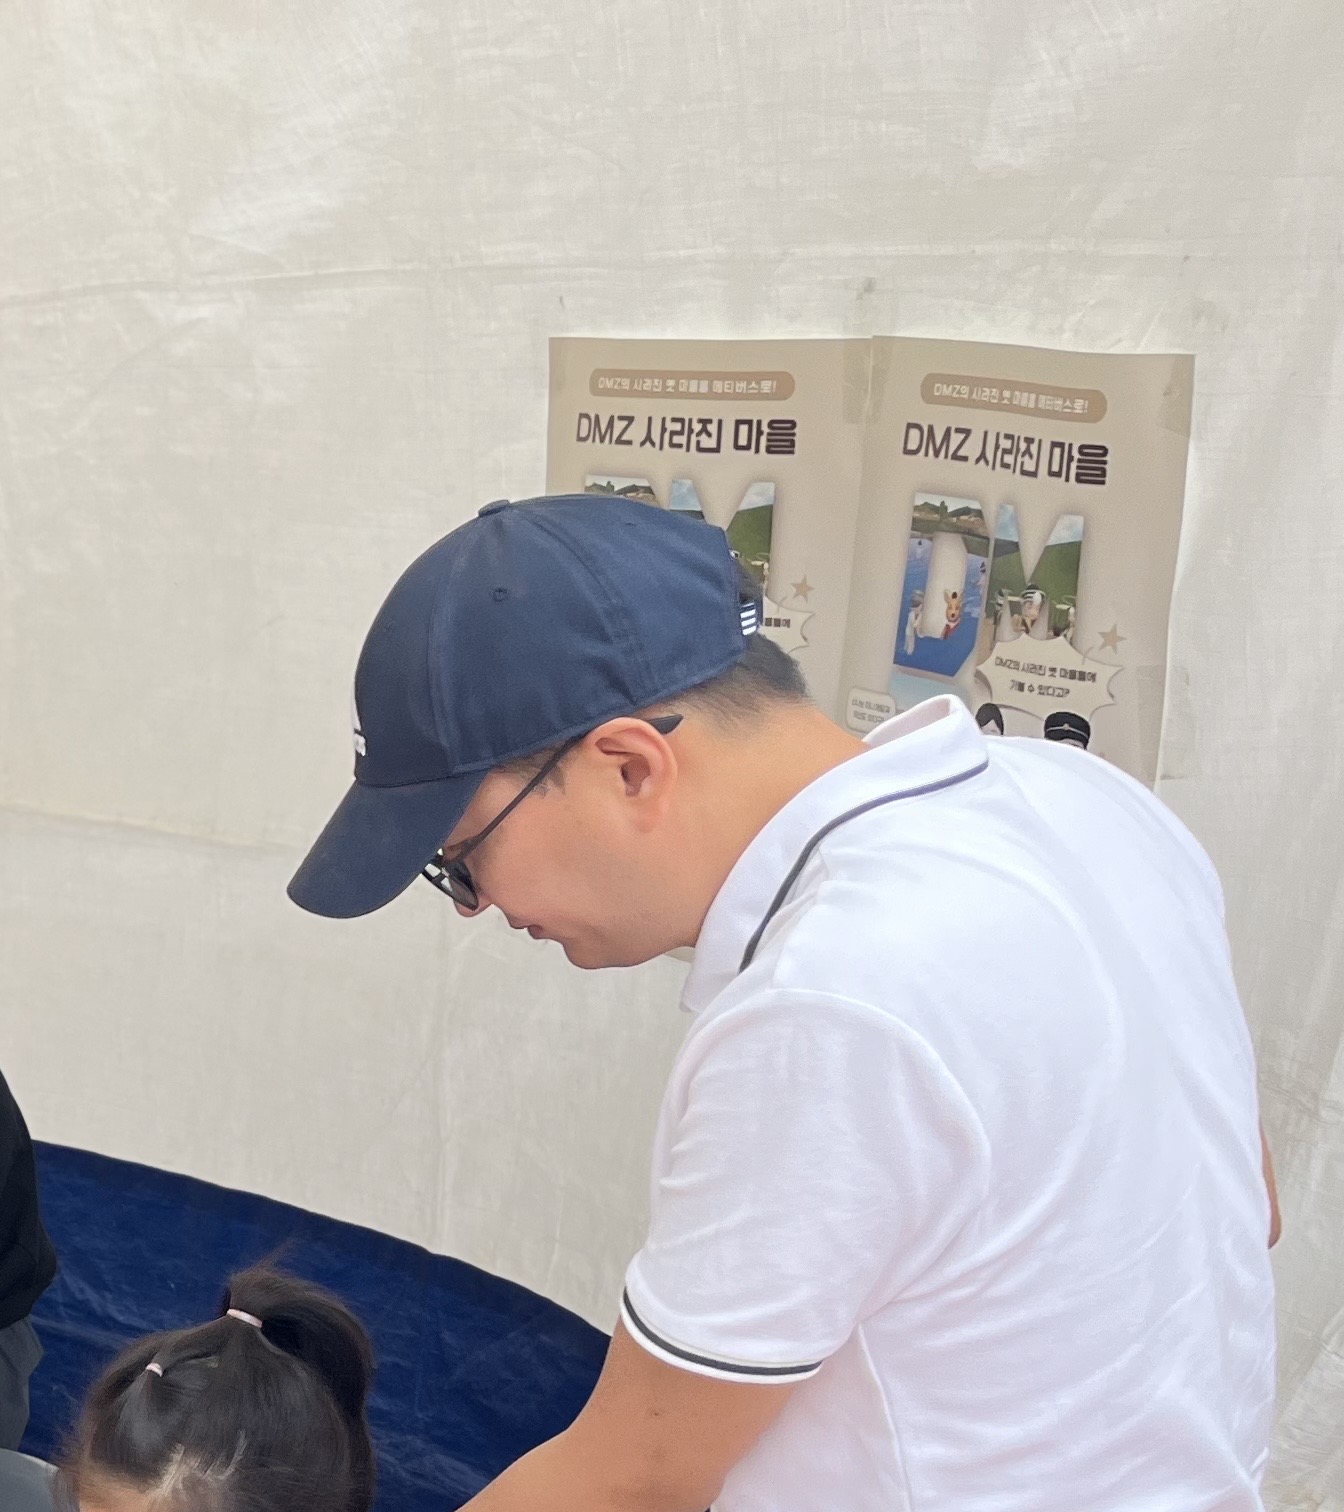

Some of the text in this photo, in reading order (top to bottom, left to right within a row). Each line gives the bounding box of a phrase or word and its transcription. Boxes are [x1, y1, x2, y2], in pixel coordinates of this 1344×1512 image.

[598, 377, 630, 391] DMZ의
[633, 378, 662, 393] 사라진
[933, 382, 970, 398] DMZ의
[972, 387, 1000, 404] 사라진
[576, 412, 798, 455] DMZ 사라진 마을
[902, 421, 1109, 485] DMZ 사라진 마을
